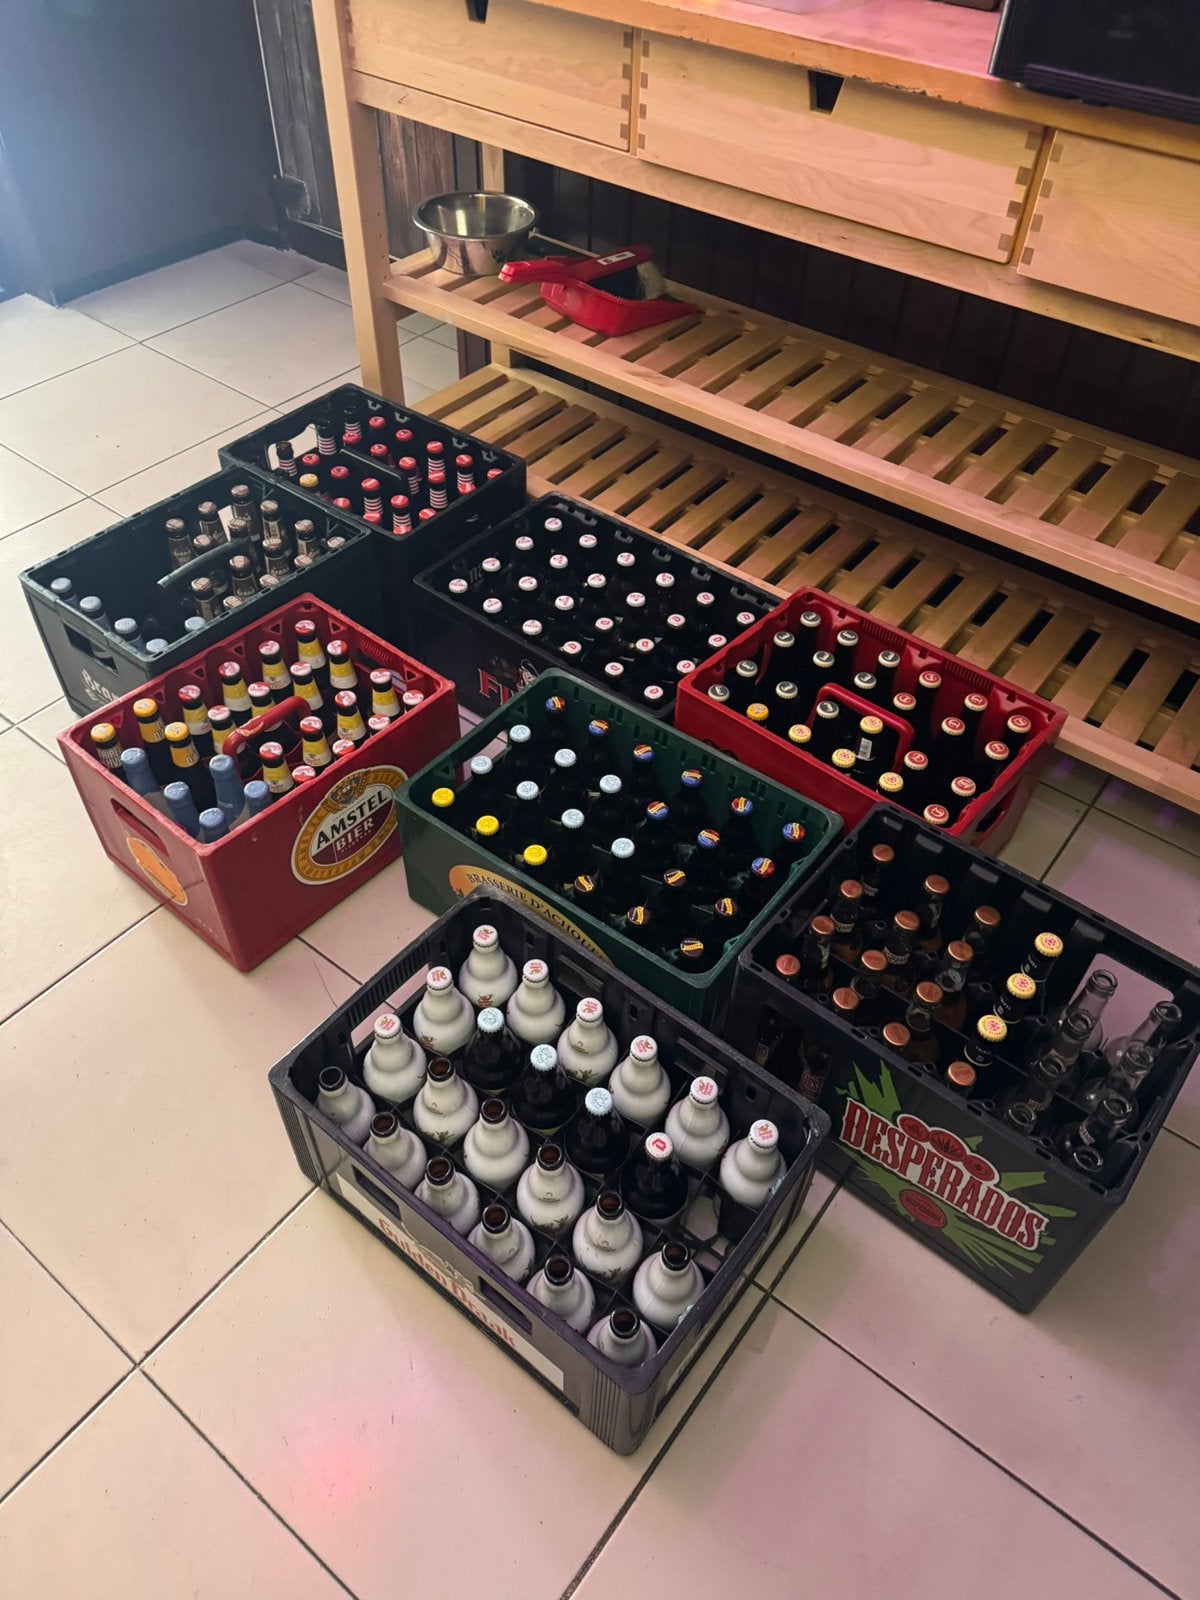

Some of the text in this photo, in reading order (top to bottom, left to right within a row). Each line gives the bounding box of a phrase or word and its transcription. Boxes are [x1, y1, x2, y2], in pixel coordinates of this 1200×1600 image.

[316, 789, 388, 850] AMSTEL
[335, 817, 374, 852] BIER
[465, 872, 603, 958] BRASSERIE D'ACHOU
[839, 1099, 1048, 1250] DESPERADOS
[378, 1217, 516, 1348] Gulden Draak
